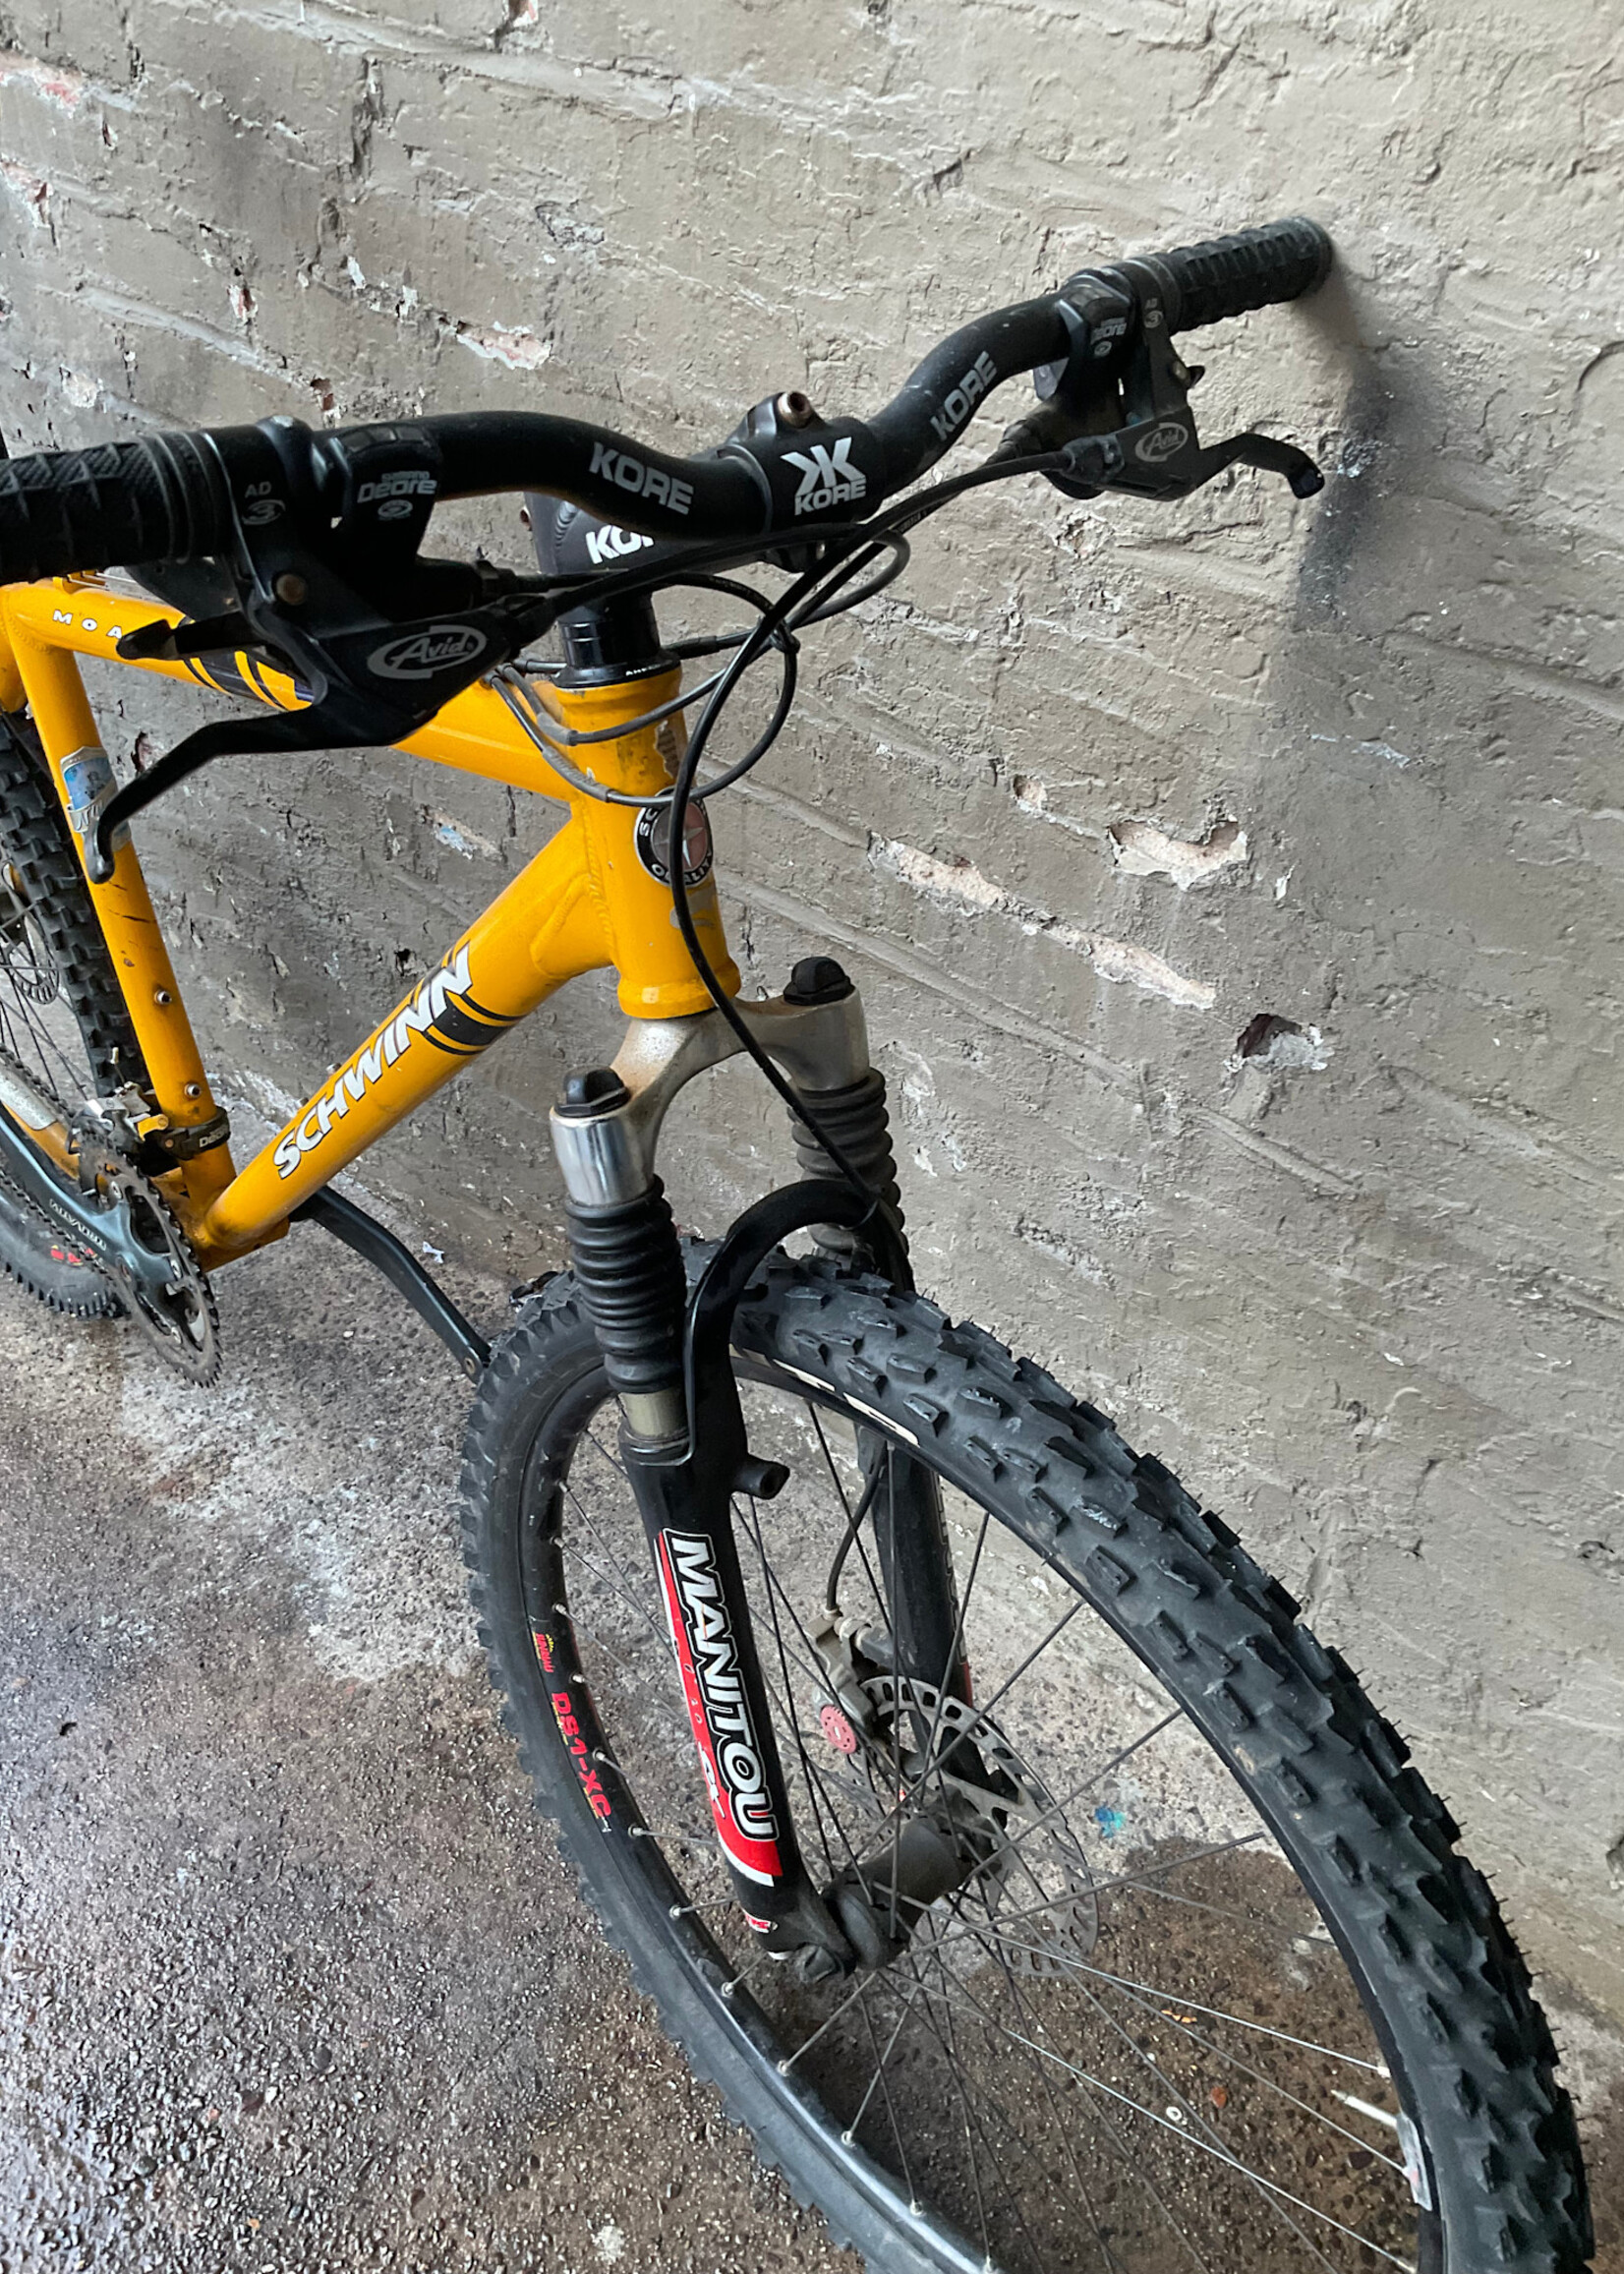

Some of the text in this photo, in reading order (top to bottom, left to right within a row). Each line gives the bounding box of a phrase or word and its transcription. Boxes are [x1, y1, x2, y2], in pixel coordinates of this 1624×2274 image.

[930, 350, 997, 441] KORE
[245, 482, 272, 498] AD
[357, 479, 437, 503] Deore
[589, 441, 695, 515] KORE
[794, 477, 867, 516] KORE
[585, 524, 654, 564] KO
[52, 609, 123, 640] MOA
[273, 940, 473, 1180] SCHWINN
[670, 1536, 775, 1837] MANITOU
[551, 1692, 610, 1817] DS1-XC
